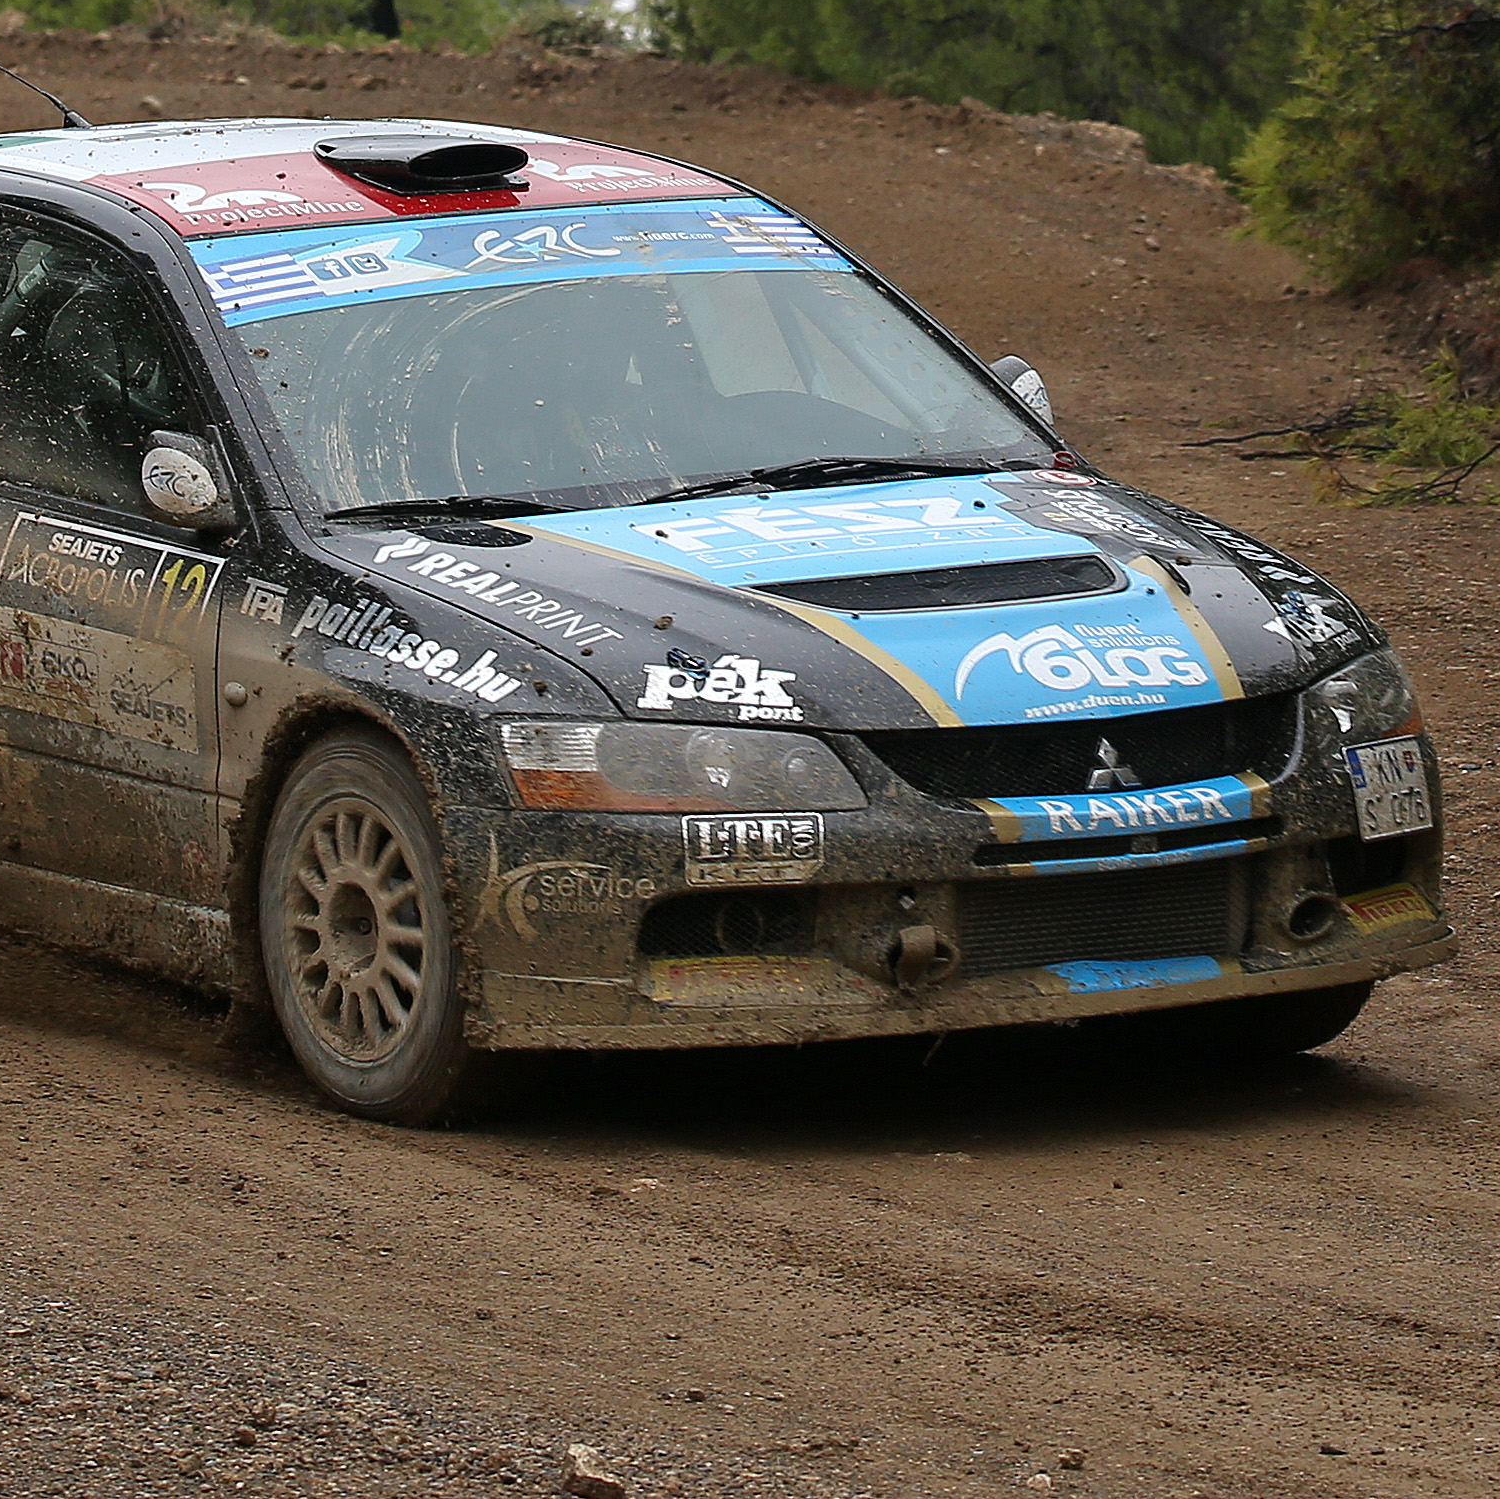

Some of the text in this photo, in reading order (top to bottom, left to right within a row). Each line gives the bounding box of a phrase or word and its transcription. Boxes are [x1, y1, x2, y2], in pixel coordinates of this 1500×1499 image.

[7, 544, 146, 609] ACROPOLIS
[48, 532, 124, 567] SEAJETS
[154, 558, 207, 644] 12
[406, 552, 625, 647] REALPRINT
[290, 595, 522, 703] paillasse.hu
[737, 705, 804, 722] pont
[1036, 786, 1233, 834] RAIKER
[540, 875, 656, 898] service
